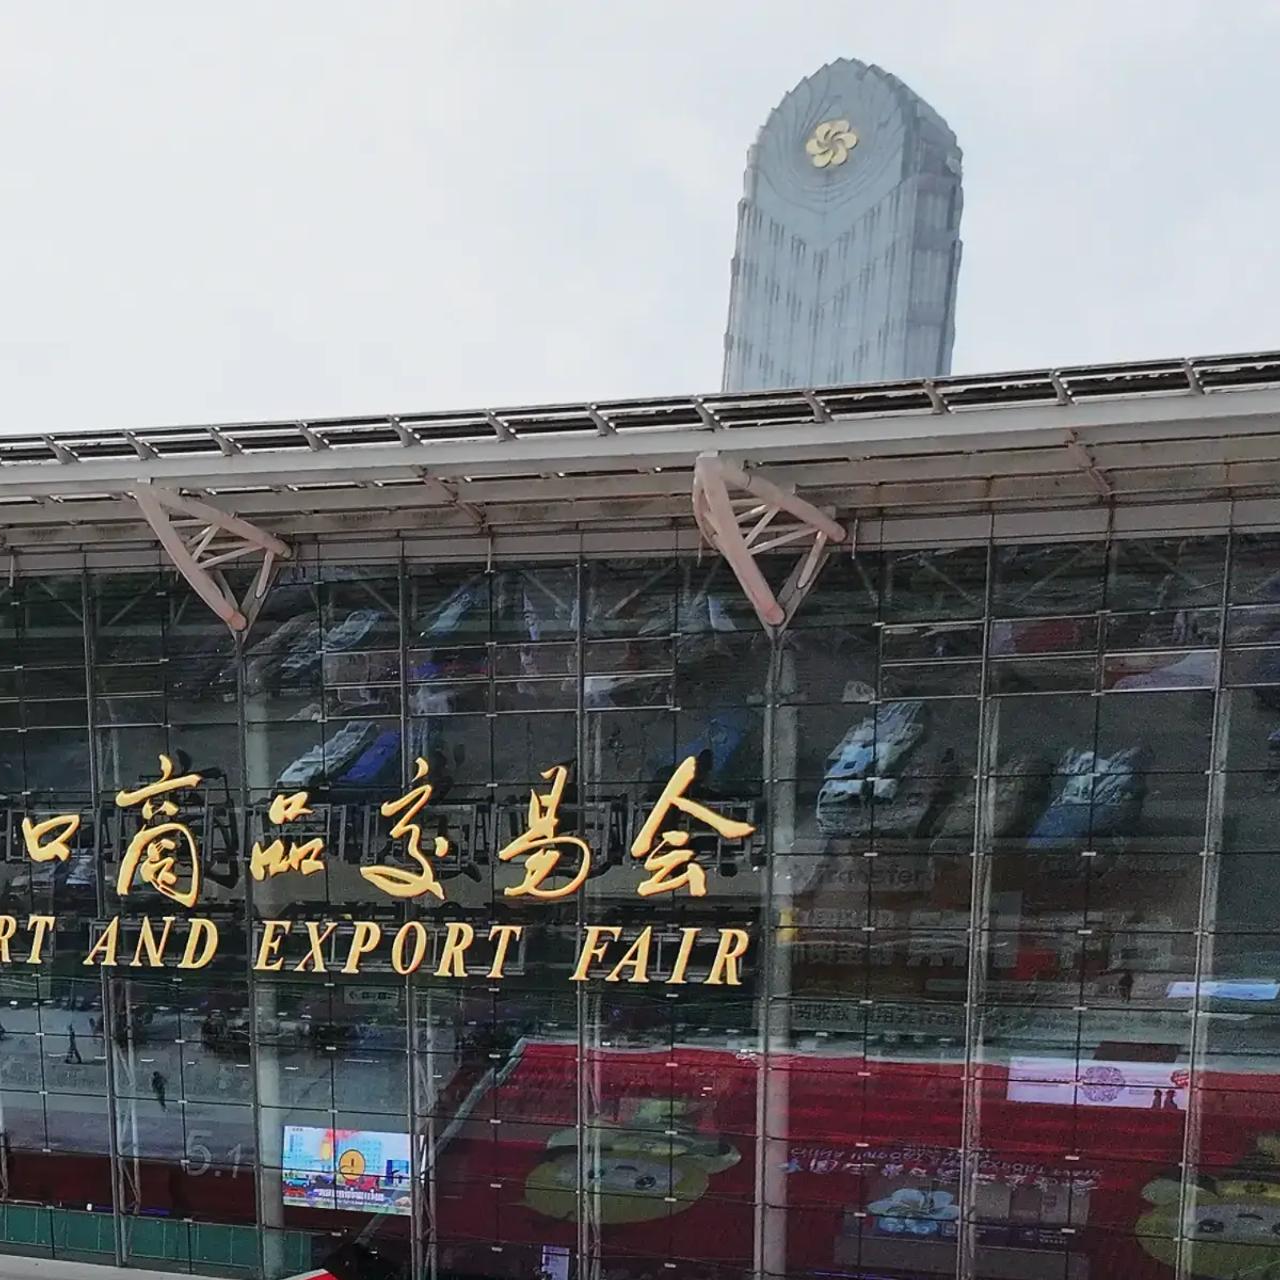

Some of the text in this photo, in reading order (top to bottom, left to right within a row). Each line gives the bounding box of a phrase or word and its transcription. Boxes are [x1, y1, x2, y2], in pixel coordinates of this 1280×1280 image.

[82, 916, 220, 970] AND
[252, 920, 523, 978] EXPORT
[575, 924, 752, 986] FAIR
